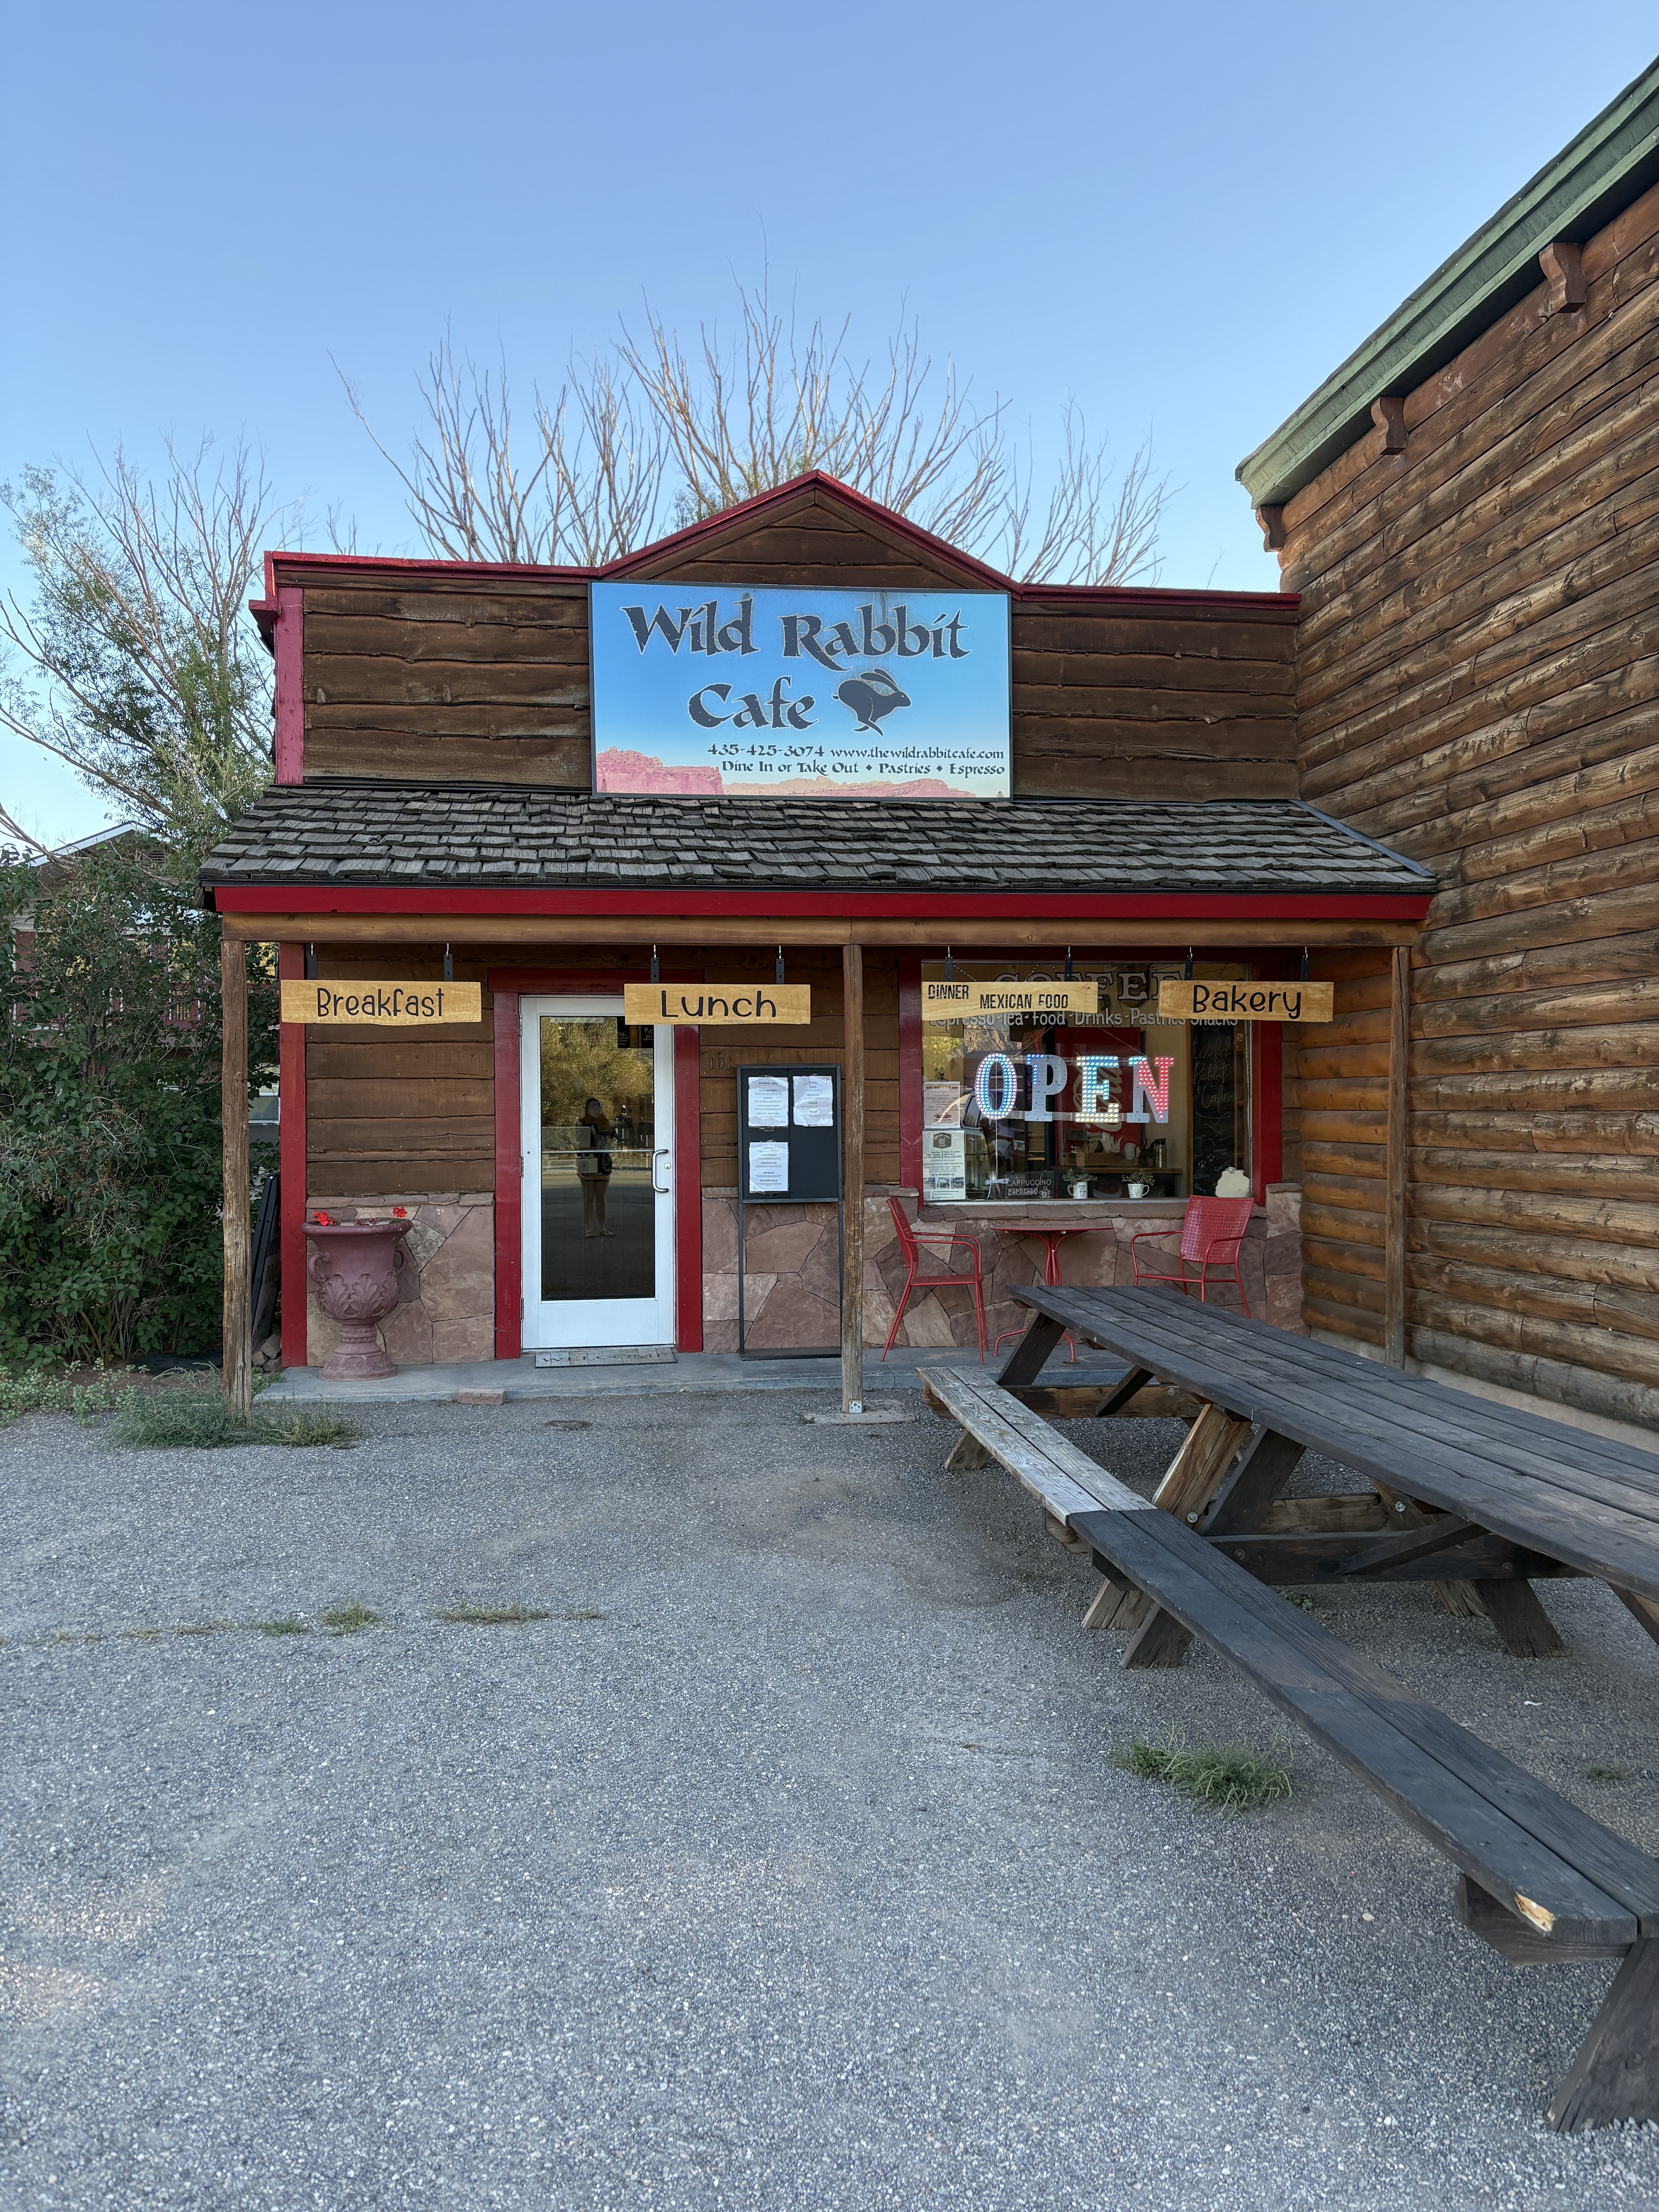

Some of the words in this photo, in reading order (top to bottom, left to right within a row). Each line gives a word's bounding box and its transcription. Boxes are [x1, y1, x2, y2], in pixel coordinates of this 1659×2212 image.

[620, 597, 760, 655] Wild
[778, 603, 972, 671] Rabbit
[688, 676, 818, 729] Cafe
[707, 743, 825, 757] 435-425-3074
[830, 746, 1004, 759] www.thewildrabbitcafe.com
[722, 760, 753, 771] Dine
[759, 761, 773, 772] In
[778, 763, 792, 772] or
[796, 759, 830, 776] Take
[832, 761, 859, 773] Out
[879, 761, 930, 774] Pastries
[950, 763, 1005, 778] Espresso
[317, 988, 444, 1018] Breakfast
[661, 990, 776, 1018] Lunch
[928, 984, 969, 1000] DINNER
[980, 994, 1032, 1009] MEXICAN
[1039, 994, 1068, 1009] FOOD
[1193, 985, 1301, 1019] Bakery
[710, 1056, 730, 1070] 101
[975, 1053, 1174, 1124] OPEN
